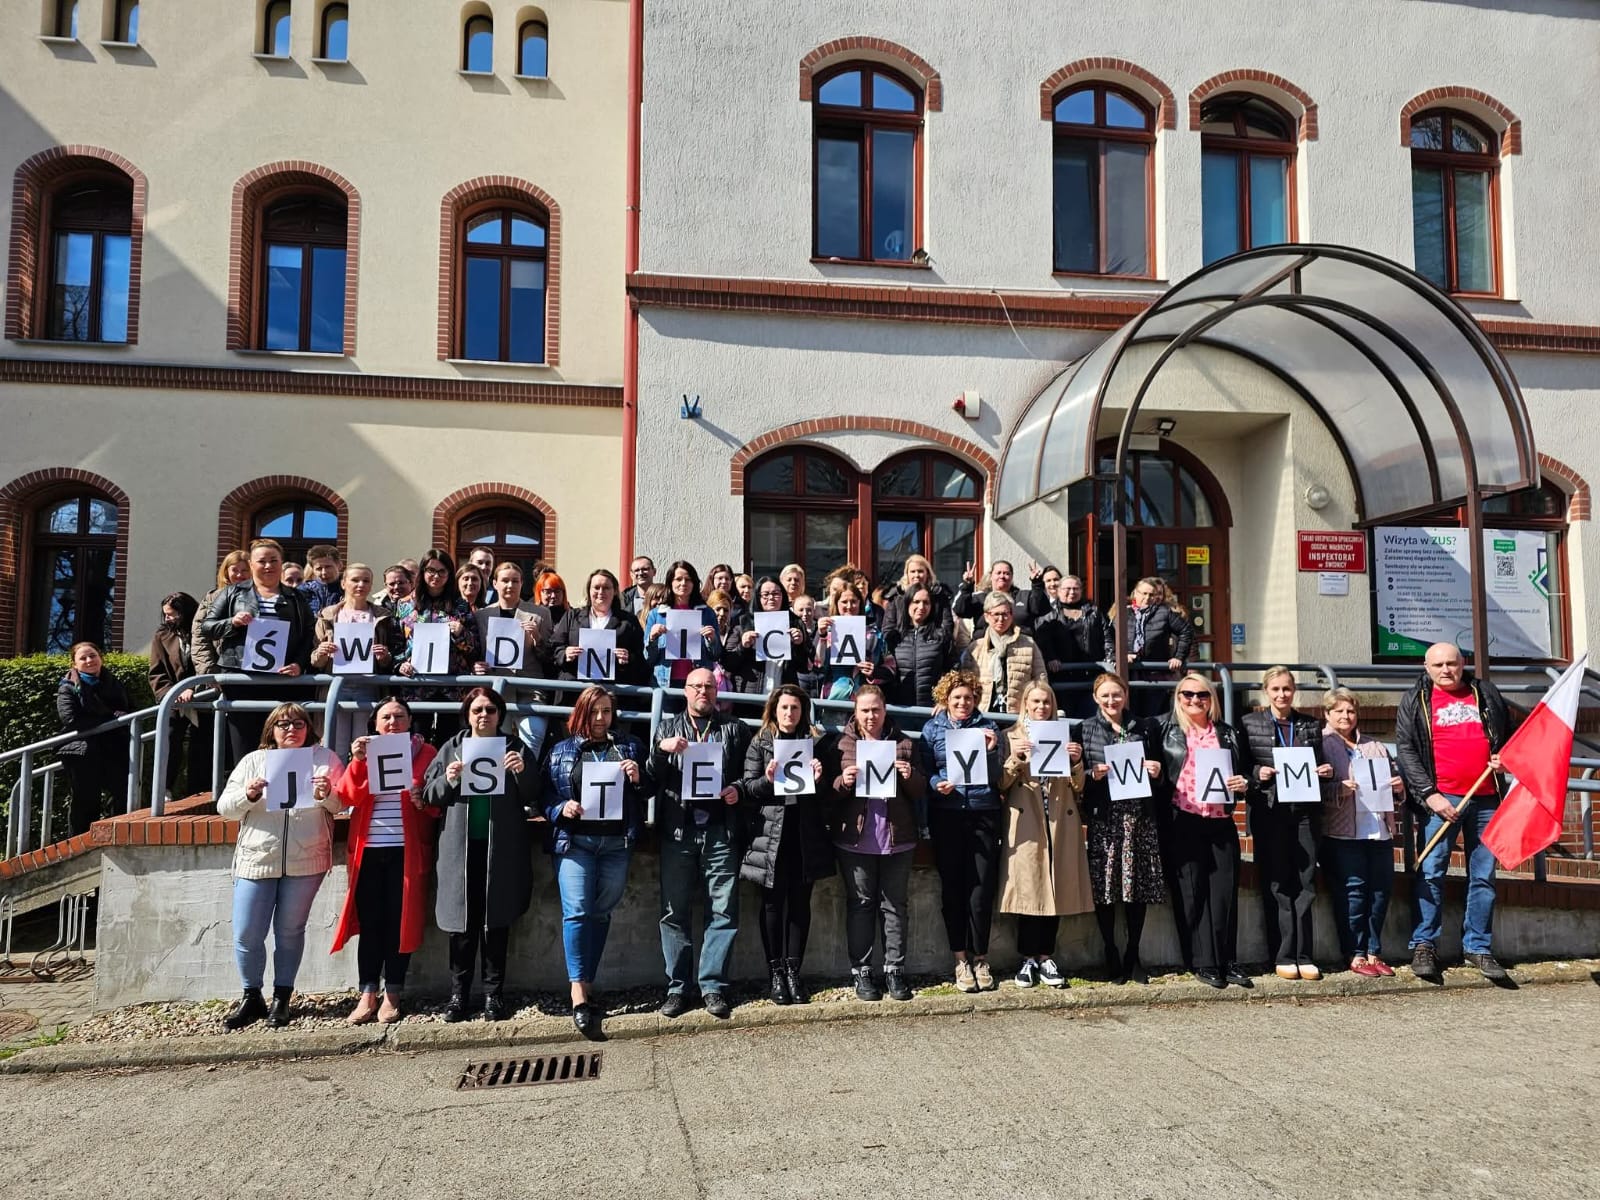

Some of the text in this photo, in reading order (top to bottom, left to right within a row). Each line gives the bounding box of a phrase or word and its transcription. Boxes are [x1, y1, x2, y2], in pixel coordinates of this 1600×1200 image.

[1309, 552, 1355, 561] INSPEKTORAT
[1384, 535, 1418, 546] Wizyta
[1431, 536, 1457, 546] ZUS?
[252, 630, 280, 672] Ś
[339, 637, 374, 663] W
[427, 643, 434, 672] I
[492, 637, 519, 667] D
[680, 629, 687, 658] I
[762, 629, 785, 660] C
[835, 635, 862, 664] A
[582, 647, 613, 679] N
[377, 752, 406, 791] E
[783, 751, 806, 795] Ś
[953, 750, 980, 784] Y
[1038, 740, 1063, 775] Z
[1111, 757, 1145, 786] W
[280, 770, 298, 810] J
[467, 757, 498, 795] S
[691, 760, 715, 798] E
[866, 760, 895, 796] M
[1201, 768, 1231, 803] A
[1284, 762, 1312, 788] M
[1369, 758, 1378, 792] I
[589, 782, 617, 818] T
